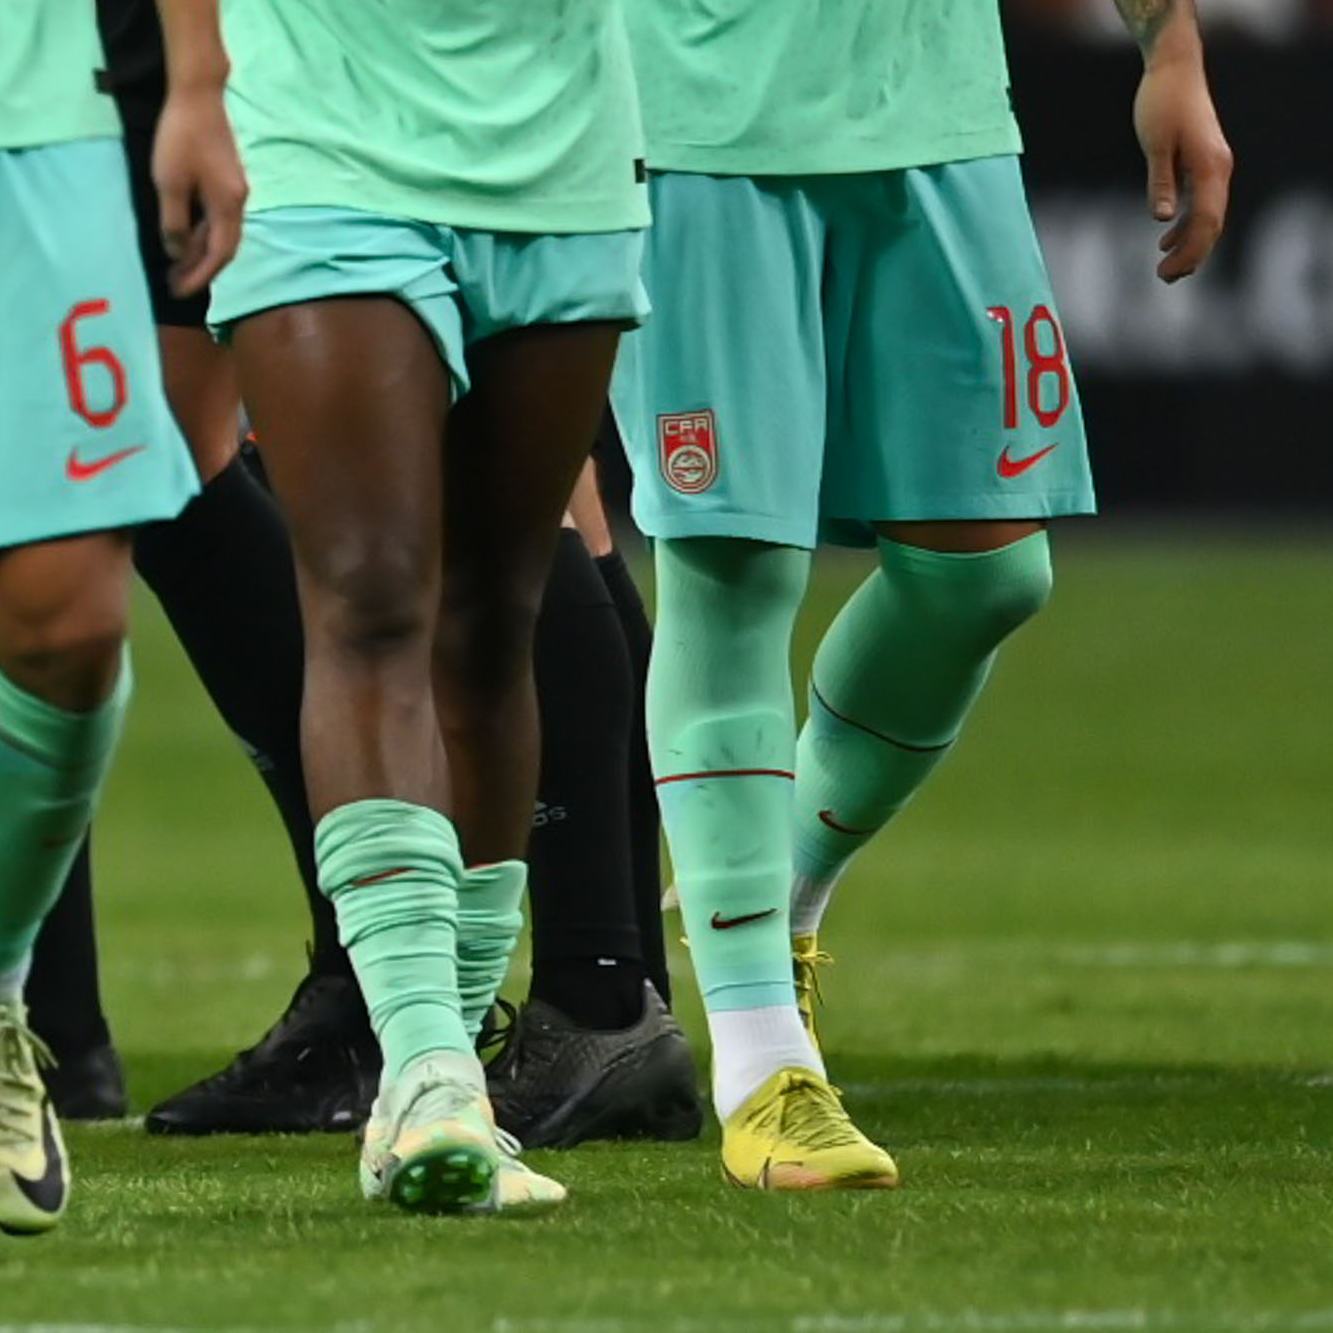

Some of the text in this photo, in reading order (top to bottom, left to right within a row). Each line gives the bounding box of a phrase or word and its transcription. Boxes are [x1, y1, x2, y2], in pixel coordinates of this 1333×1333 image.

[57, 298, 130, 428] 6
[986, 304, 1070, 429] 18
[665, 417, 709, 435] CFA
